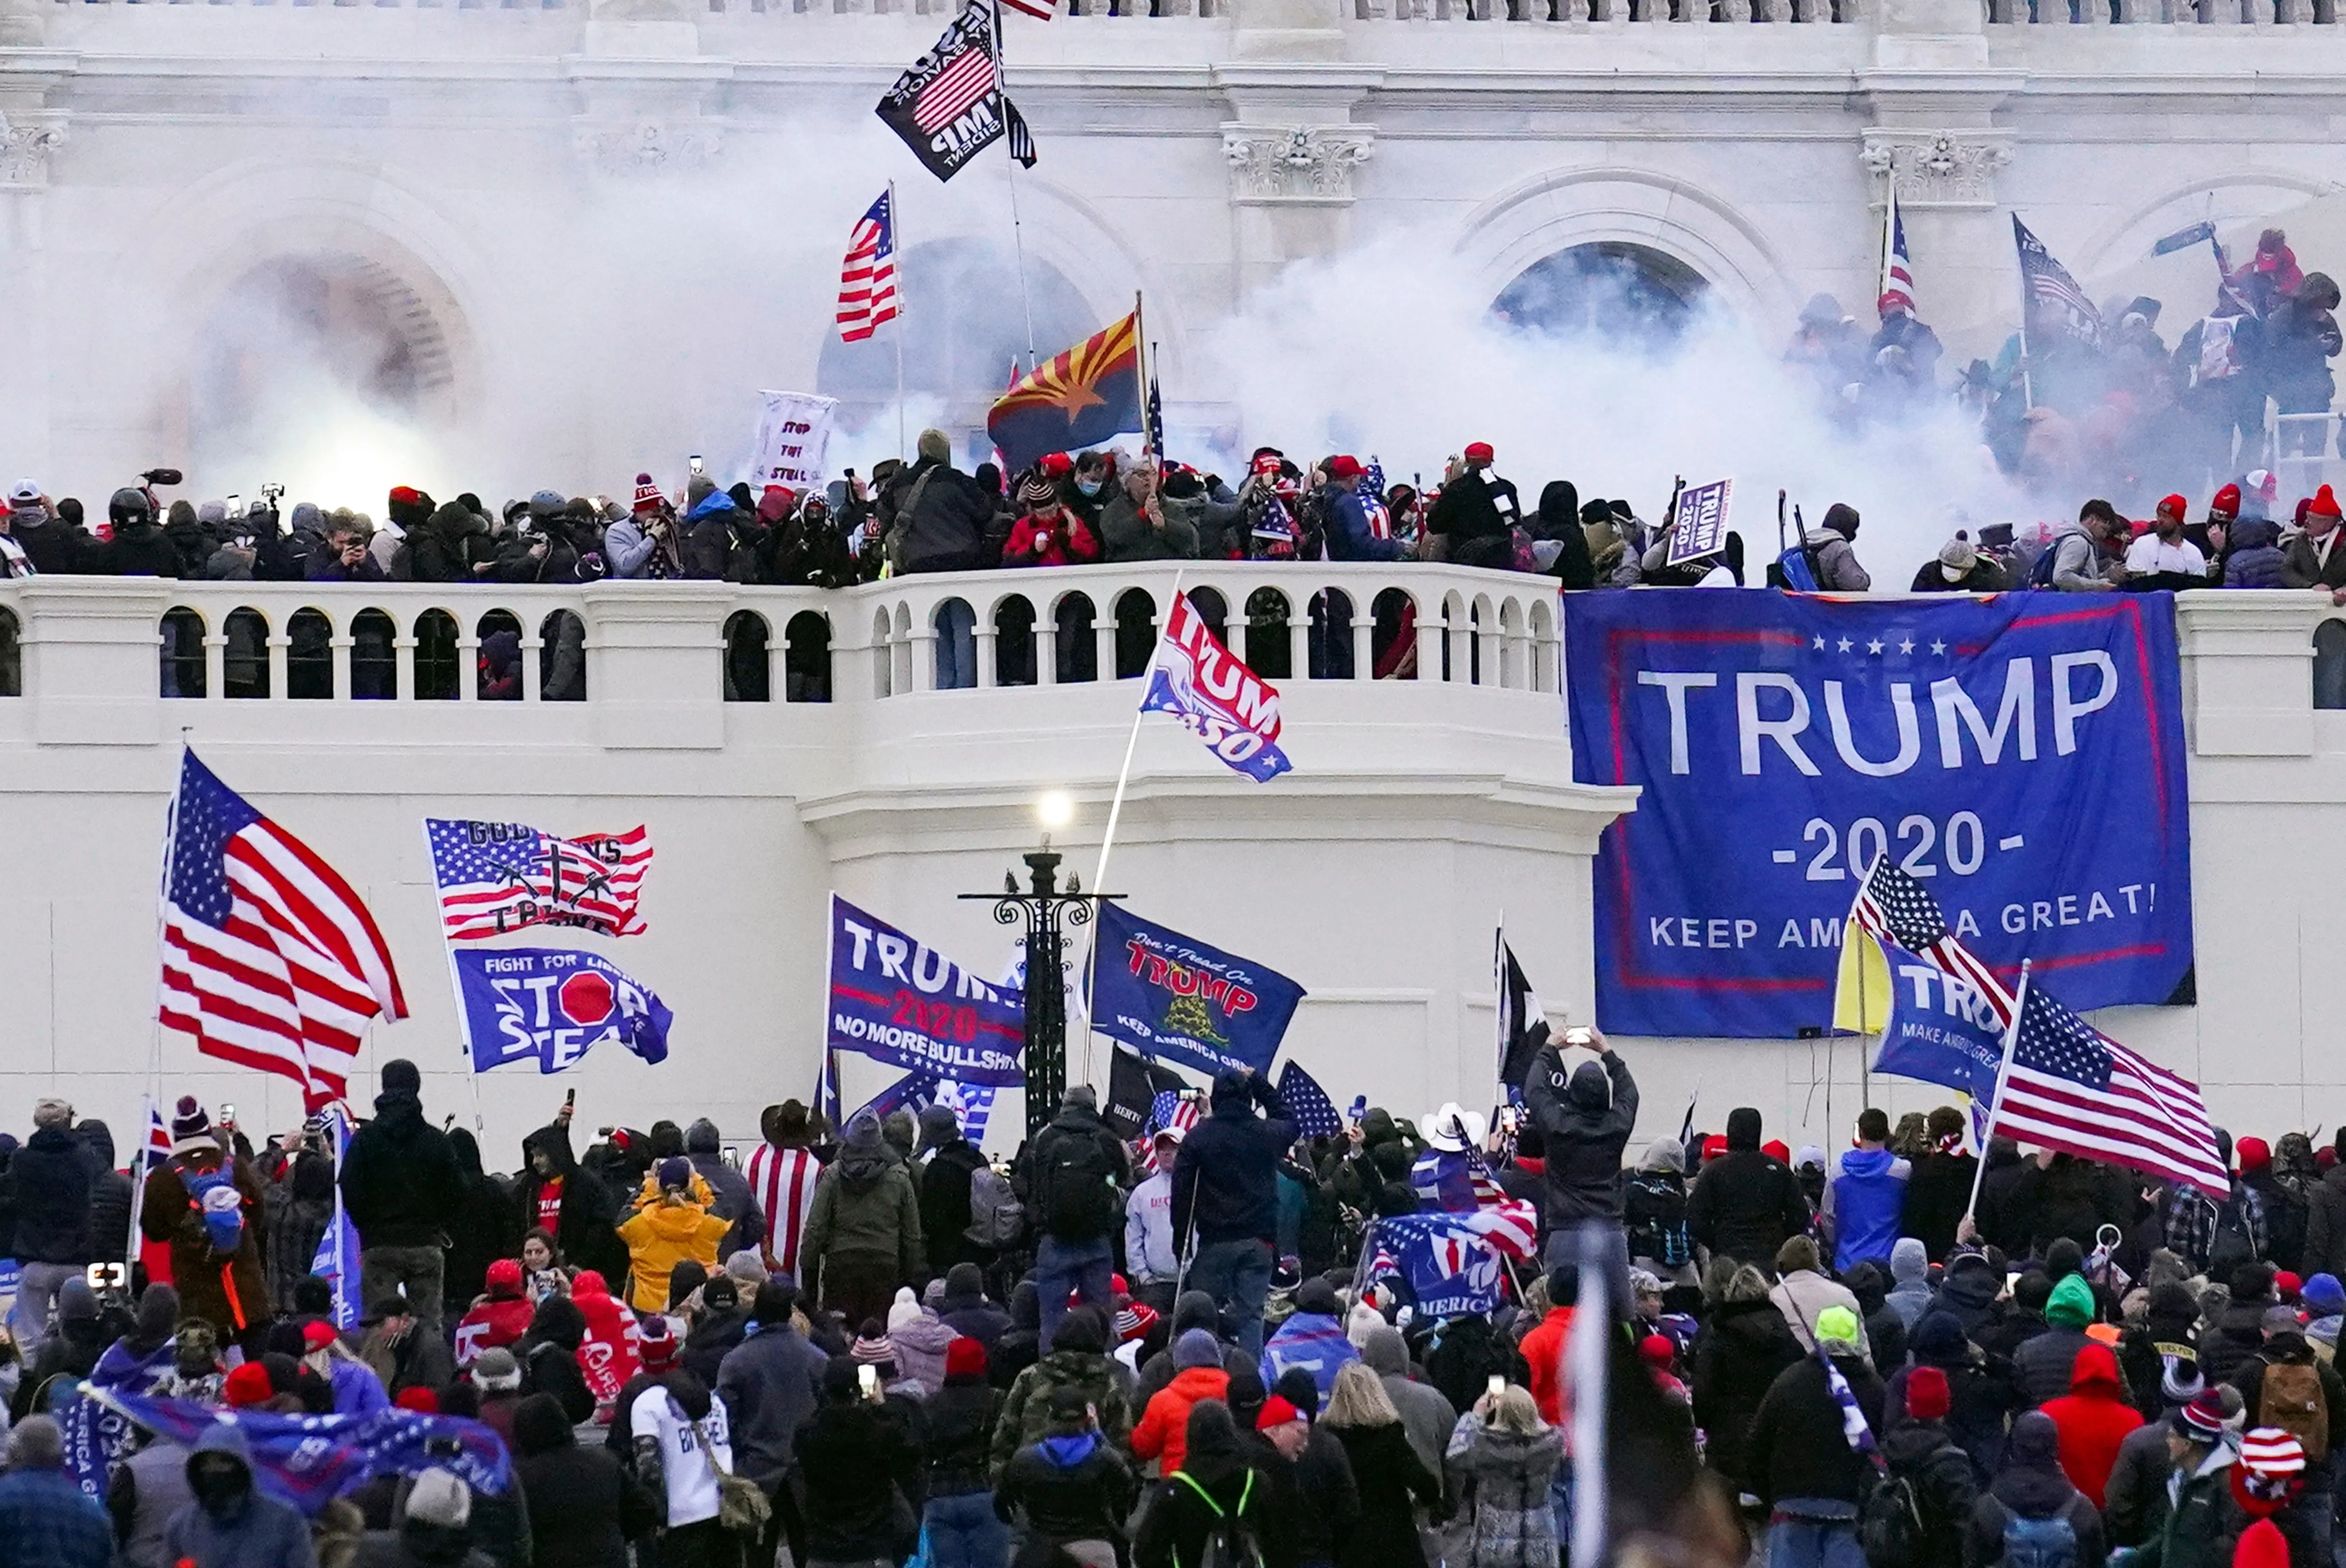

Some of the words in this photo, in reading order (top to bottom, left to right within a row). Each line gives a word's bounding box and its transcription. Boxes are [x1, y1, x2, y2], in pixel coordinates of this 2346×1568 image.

[1677, 505, 1694, 546] 2020
[1694, 485, 1721, 551] TRUMP
[1637, 649, 2119, 777] TRUMP
[1649, 916, 1758, 949] KEEP
[2000, 882, 2158, 934] GREAT!
[485, 957, 533, 973] FIGHT
[542, 954, 576, 970] FOR
[1126, 938, 1258, 1018] TRUMP
[1134, 932, 1177, 953] Don't
[1177, 948, 1228, 972] Tread
[1225, 969, 1254, 985] On
[835, 1013, 867, 1036] NO
[865, 1023, 928, 1055] MORE
[1116, 1014, 1151, 1038] KEEP
[1154, 1035, 1219, 1063] AMERICA
[1902, 1022, 1941, 1044] MAKE
[1971, 1045, 2001, 1073] GREA
